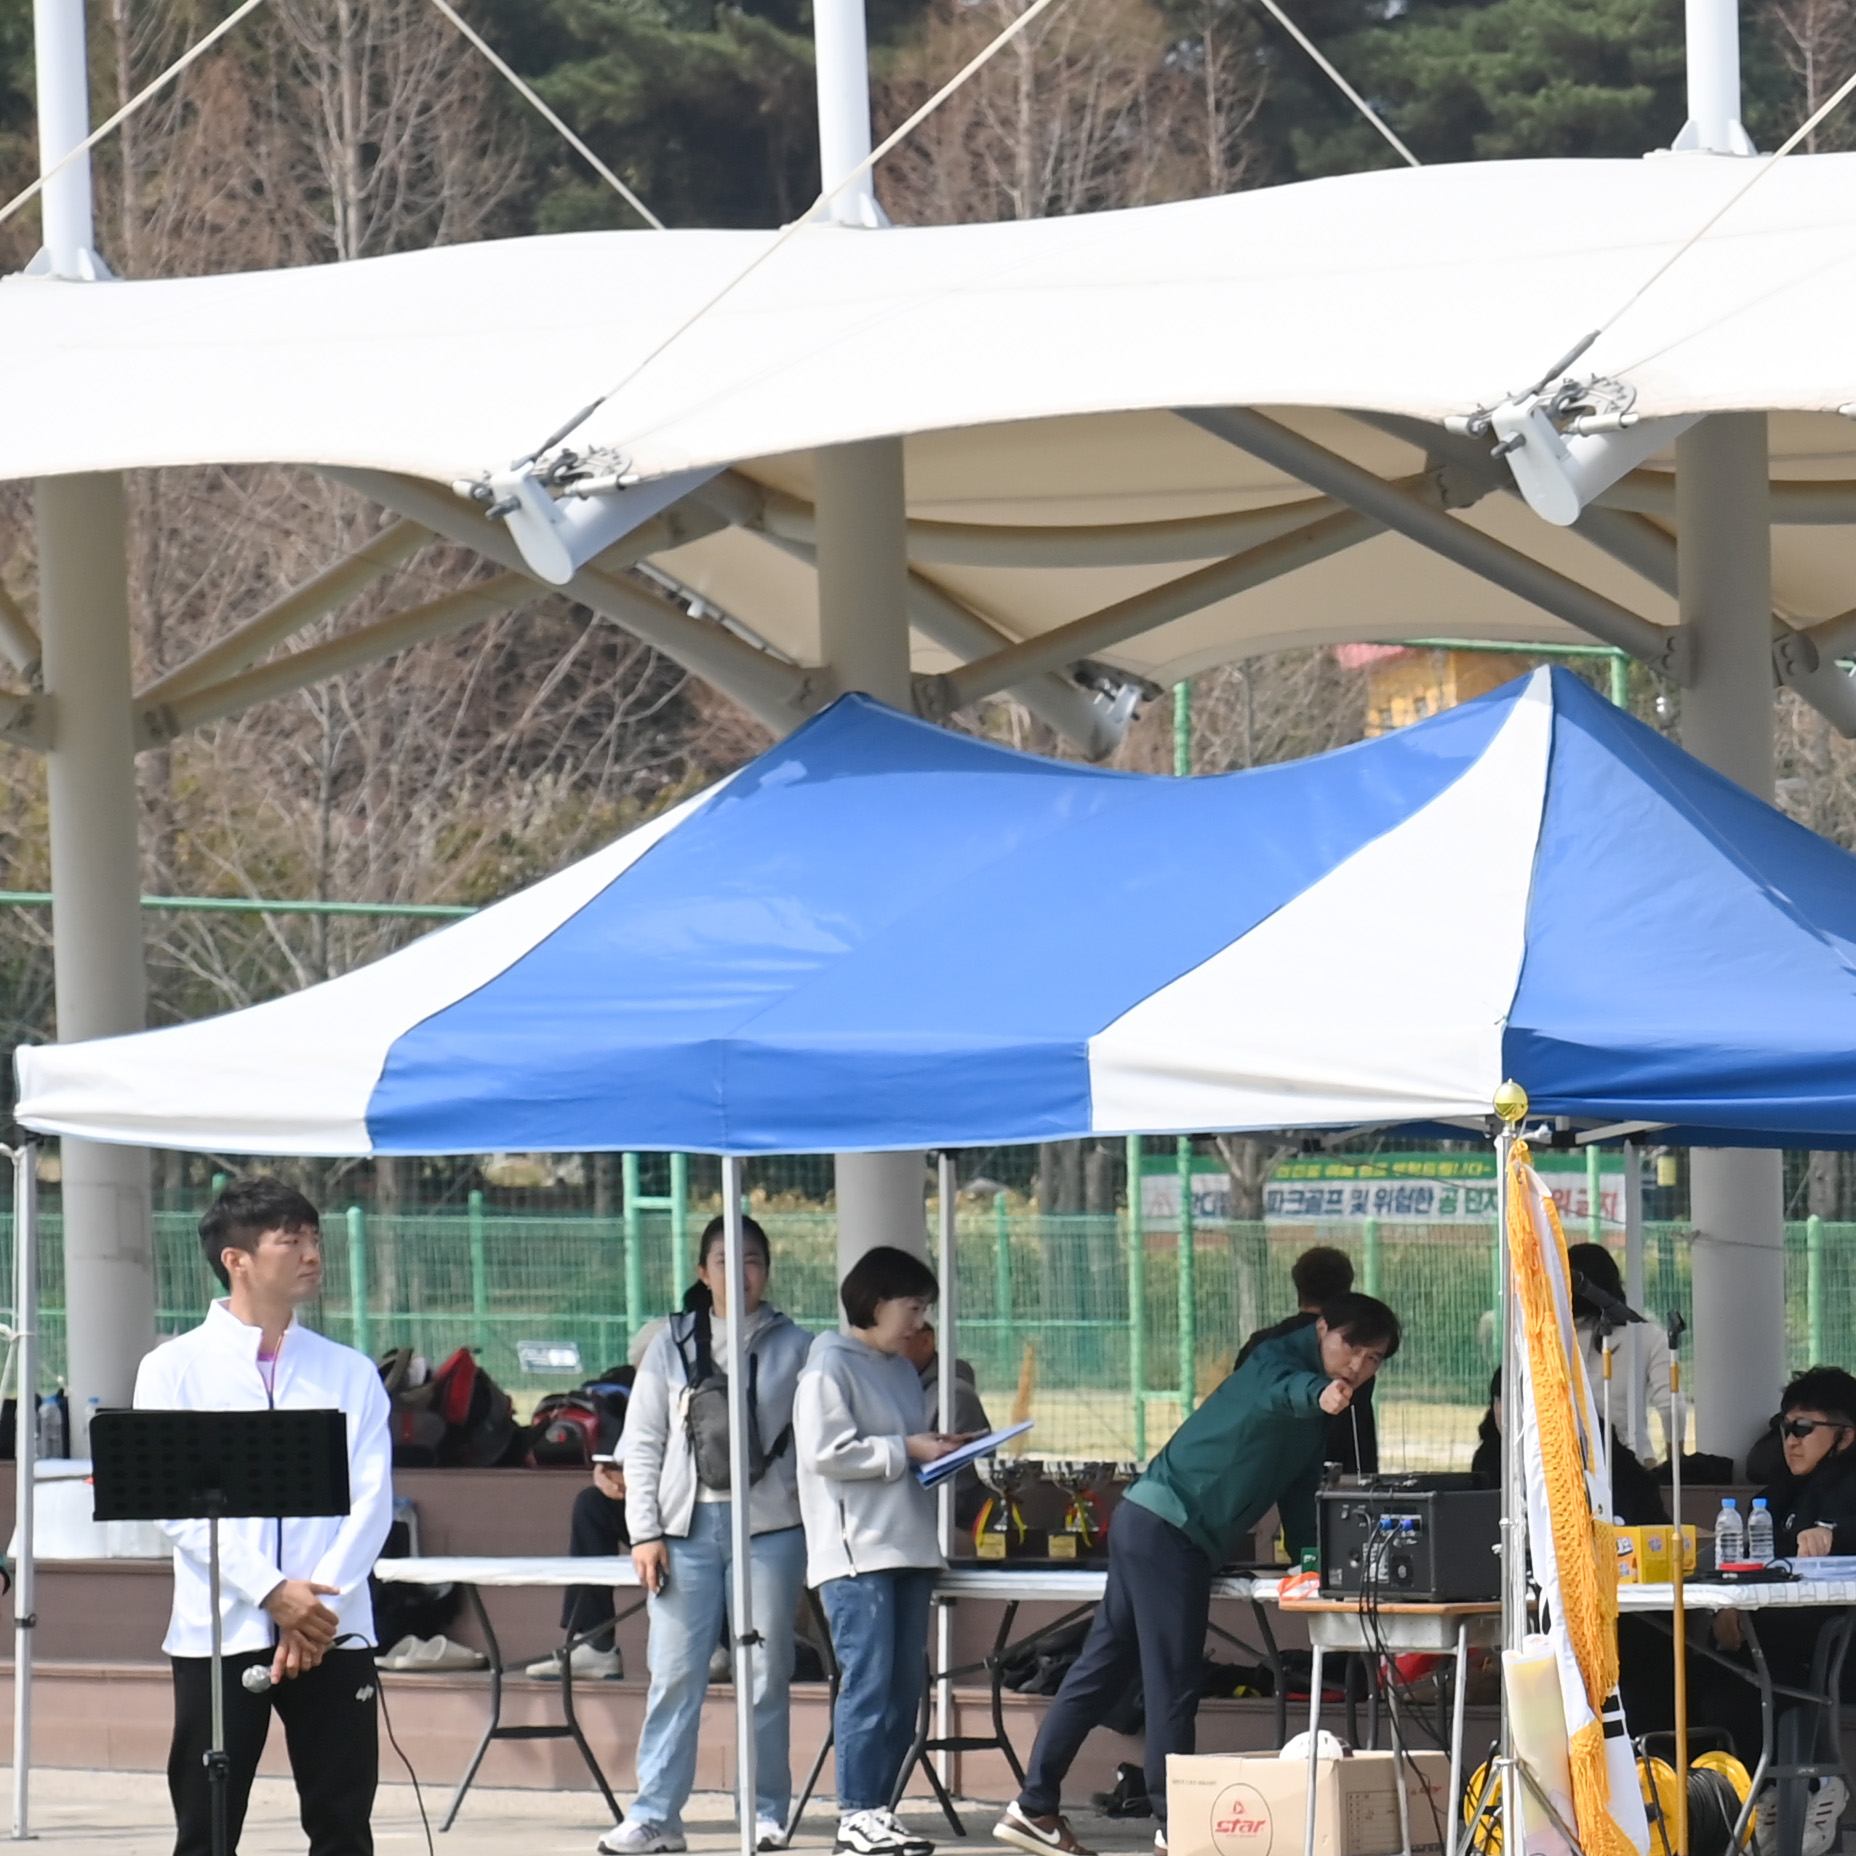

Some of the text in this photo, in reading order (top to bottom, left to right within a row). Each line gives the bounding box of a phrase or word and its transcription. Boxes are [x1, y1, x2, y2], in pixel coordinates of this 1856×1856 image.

[1267, 1188, 1344, 1216] 파크골프
[1350, 1188, 1370, 1216] 및
[1374, 1185, 1434, 1215] 위험한
[1214, 1818, 1267, 1835] star
